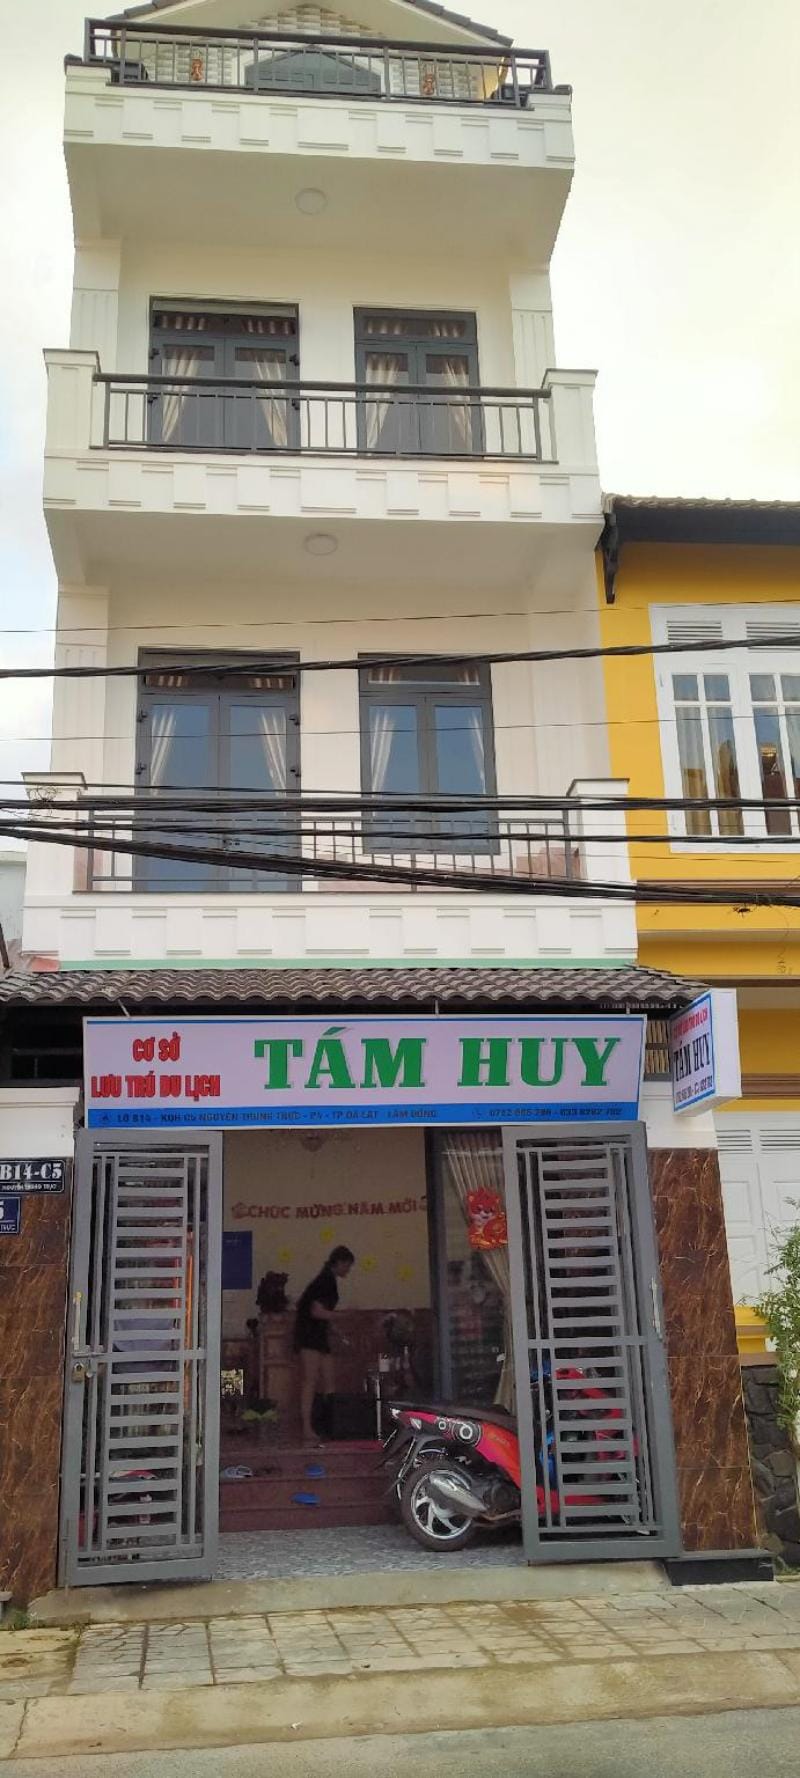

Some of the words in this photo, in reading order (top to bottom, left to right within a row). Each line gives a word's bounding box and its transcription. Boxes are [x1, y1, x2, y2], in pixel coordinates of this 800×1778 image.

[133, 1037, 156, 1062] CƠ
[158, 1031, 181, 1062] SỞ
[254, 1026, 427, 1089] TÁM
[457, 1037, 621, 1087] HUY
[673, 1040, 691, 1081] TÁM
[692, 1032, 710, 1072] HUY
[91, 1073, 122, 1098] LƯU
[125, 1070, 156, 1098] TRÚ
[159, 1074, 182, 1098] DU
[184, 1074, 221, 1101] LỊCH
[0, 1163, 62, 1180] B14-C5
